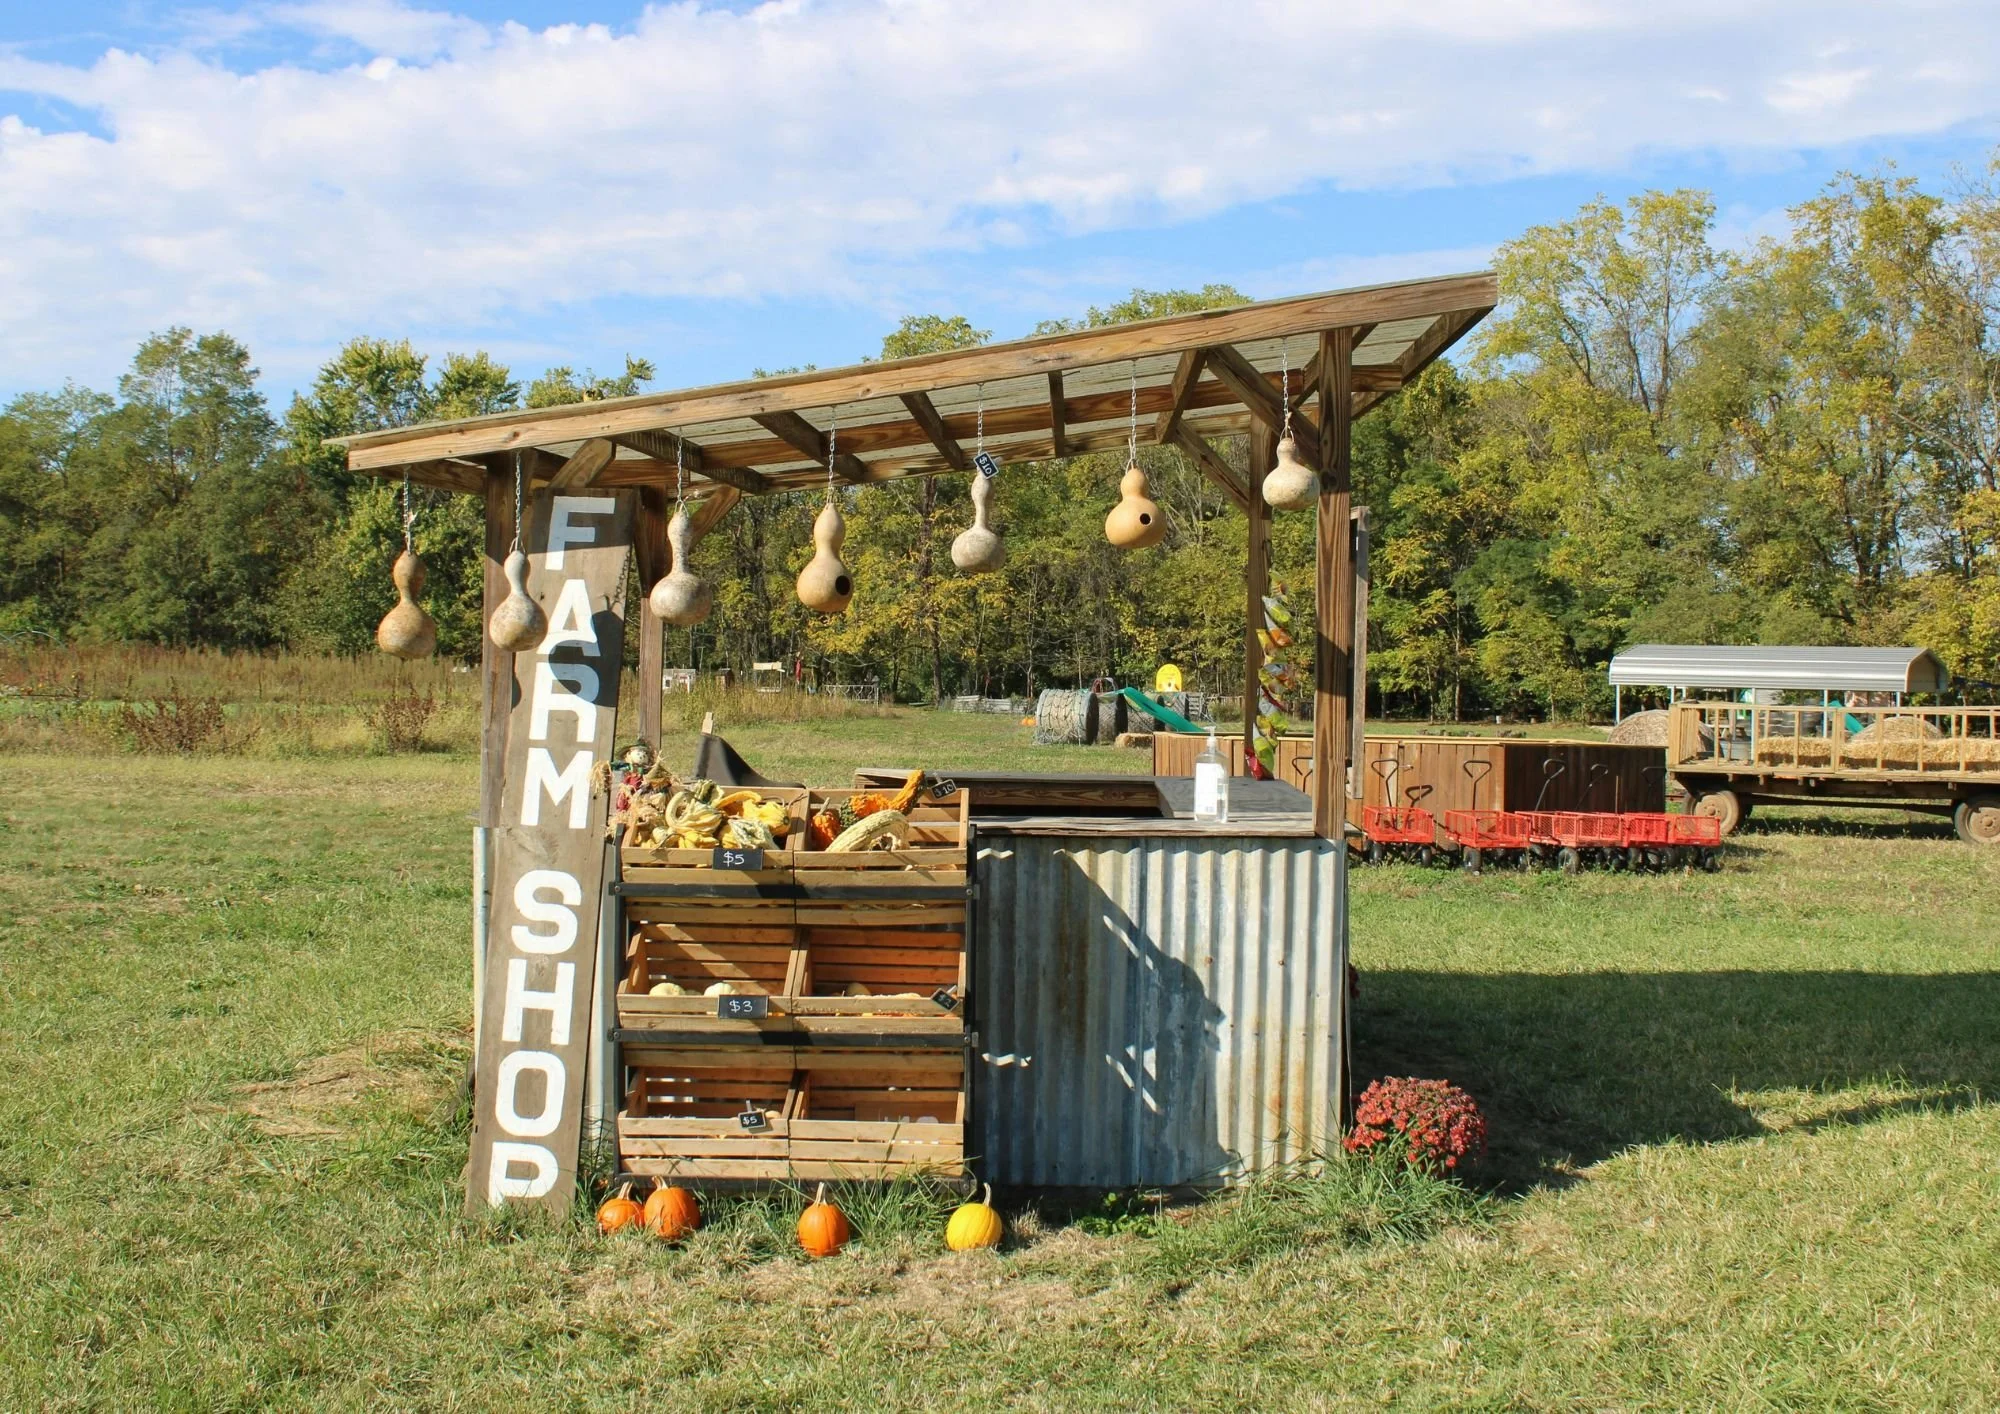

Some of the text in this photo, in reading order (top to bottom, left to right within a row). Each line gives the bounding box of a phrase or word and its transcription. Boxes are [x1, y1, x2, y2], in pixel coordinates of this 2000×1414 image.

[979, 456, 992, 475] $10
[934, 784, 954, 797] $10
[488, 496, 616, 1208] FARM SHOP
[723, 851, 745, 867] $5
[729, 1000, 753, 1014] $3
[742, 1115, 758, 1126] $5
